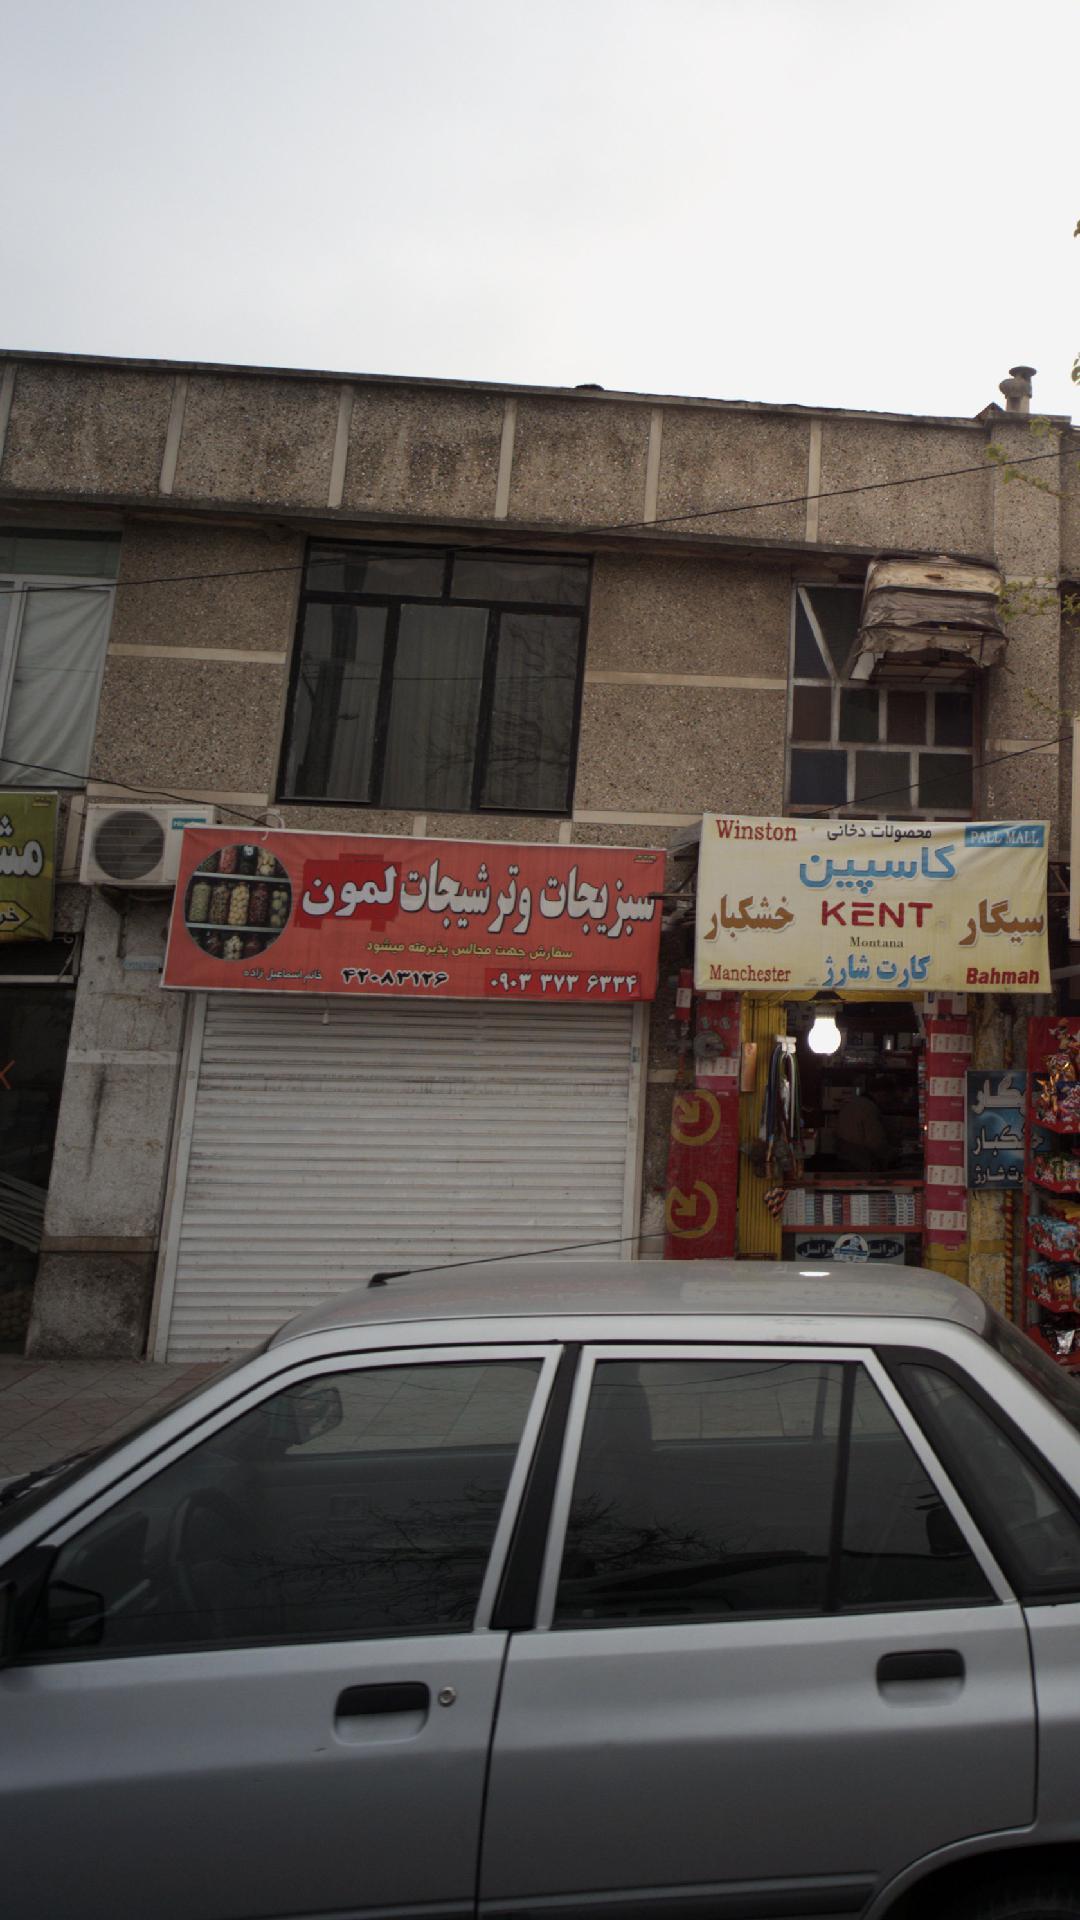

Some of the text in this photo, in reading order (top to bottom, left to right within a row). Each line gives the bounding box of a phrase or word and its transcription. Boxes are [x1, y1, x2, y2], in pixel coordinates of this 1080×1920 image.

[716, 820, 797, 841] Winston
[827, 824, 932, 842] محصولات دخانی
[971, 830, 1040, 844] PALL MALL
[800, 845, 956, 895] کاسپین
[539, 864, 656, 938] سبزیجات
[703, 894, 1045, 946] سیگار خشکبار
[821, 900, 934, 928] KENT
[408, 942, 449, 957] پذیرفته
[452, 943, 491, 957] مجالس
[850, 936, 904, 948] Montana
[495, 946, 526, 957] جهت
[529, 945, 574, 960] سفارش
[709, 964, 792, 982] Manchester
[822, 954, 932, 988] کارت شارژ
[966, 967, 1039, 984] Bahman
